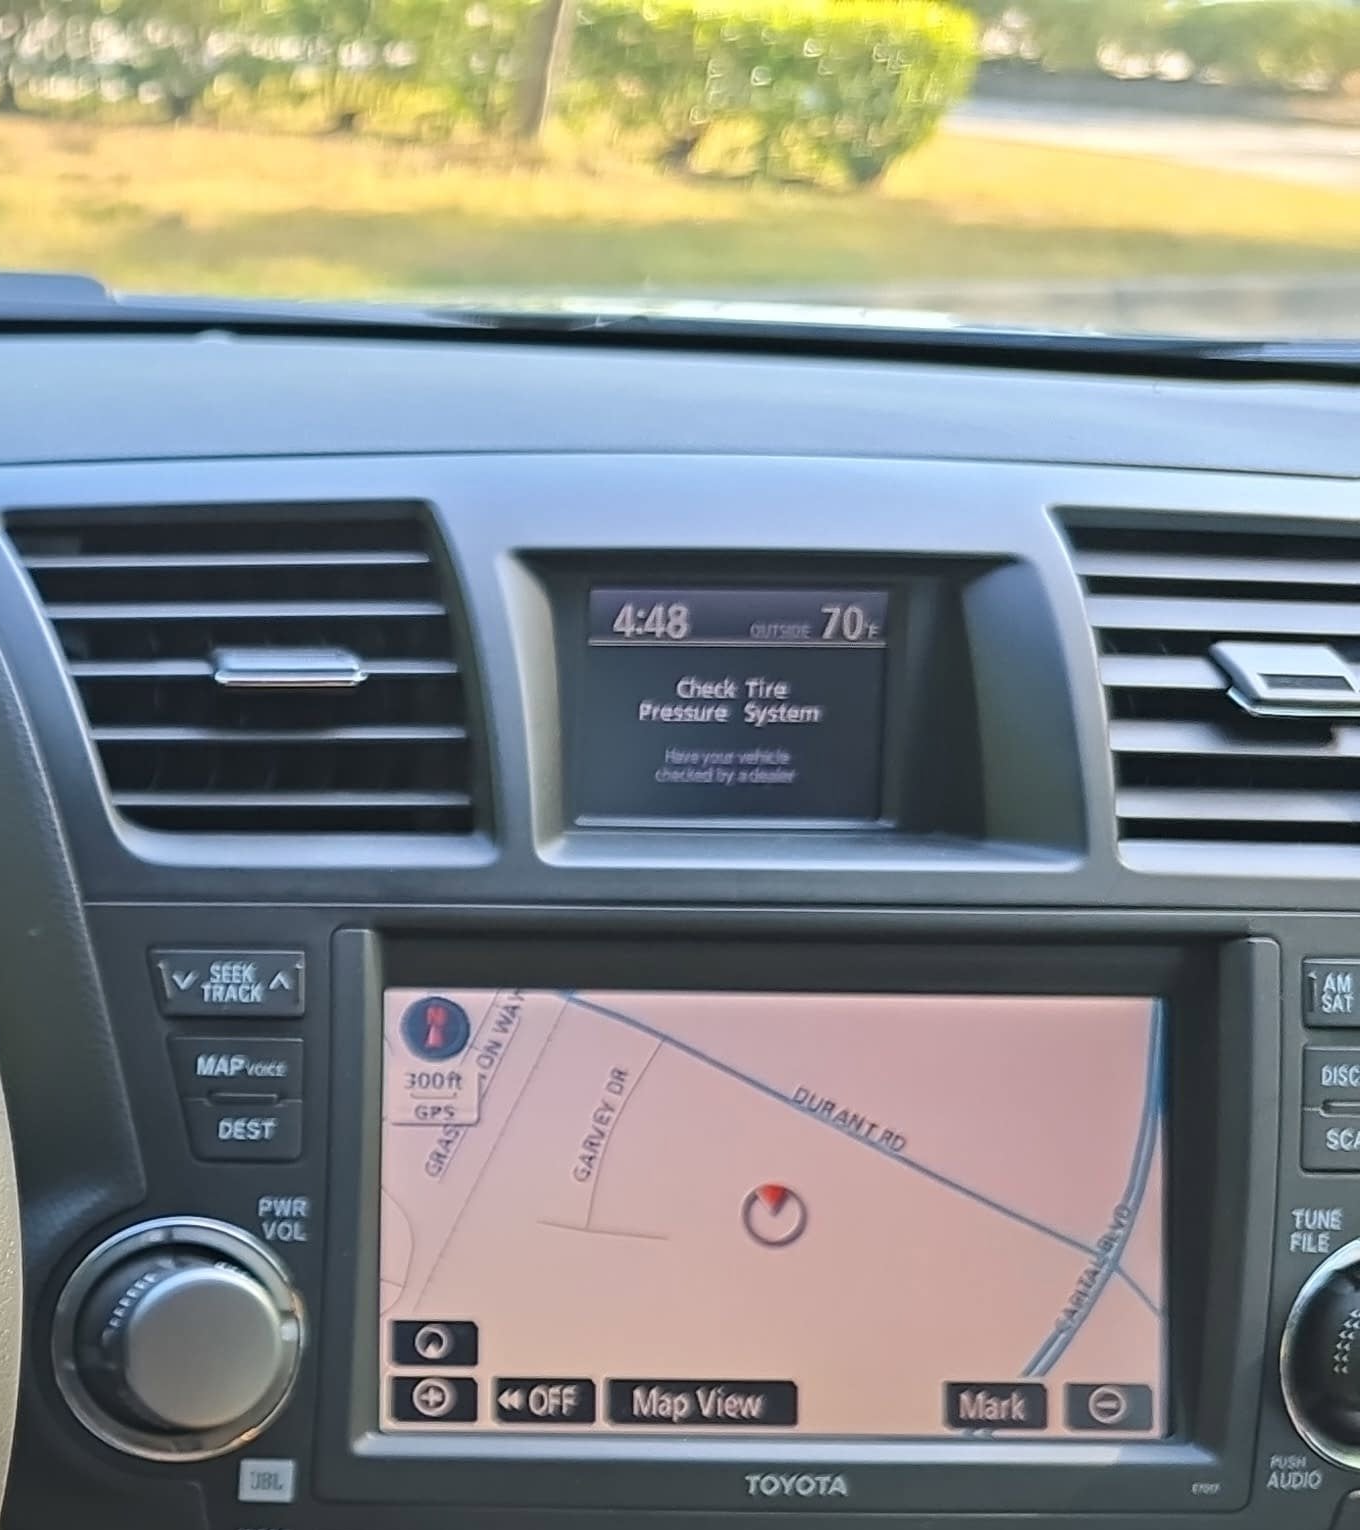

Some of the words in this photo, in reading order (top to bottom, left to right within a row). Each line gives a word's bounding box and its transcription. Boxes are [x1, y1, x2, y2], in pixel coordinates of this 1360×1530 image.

[613, 604, 691, 640] 4:48
[750, 623, 812, 639] OUTSIDE
[676, 676, 735, 699] Check
[745, 677, 790, 699] Tire
[639, 703, 729, 722] Pressure
[743, 703, 821, 727] System
[209, 961, 255, 984] SEEK
[1321, 972, 1353, 995] AM
[201, 981, 262, 1004] TRACK
[1320, 992, 1355, 1015] SAT
[196, 1055, 244, 1078] MAP
[245, 1058, 288, 1077] VOICE
[414, 1104, 456, 1121] GPS
[792, 1086, 878, 1139] DURANT
[877, 1126, 908, 1153] RD
[217, 1117, 276, 1141] DEST
[571, 1098, 616, 1184] GARVEY
[602, 1066, 629, 1099] DR
[259, 1198, 307, 1219] PWR
[1292, 1208, 1344, 1232] TUNE
[262, 1219, 307, 1242] VOL
[1290, 1231, 1331, 1255] FILE
[528, 1387, 578, 1417] OFF
[632, 1388, 688, 1421] Map
[695, 1386, 762, 1417] View
[958, 1390, 1027, 1422] Mark
[1270, 1455, 1307, 1470] PUSH
[250, 1471, 284, 1490] JBL
[745, 1473, 849, 1497] TOYOTA
[1266, 1471, 1323, 1490] AUDIO
